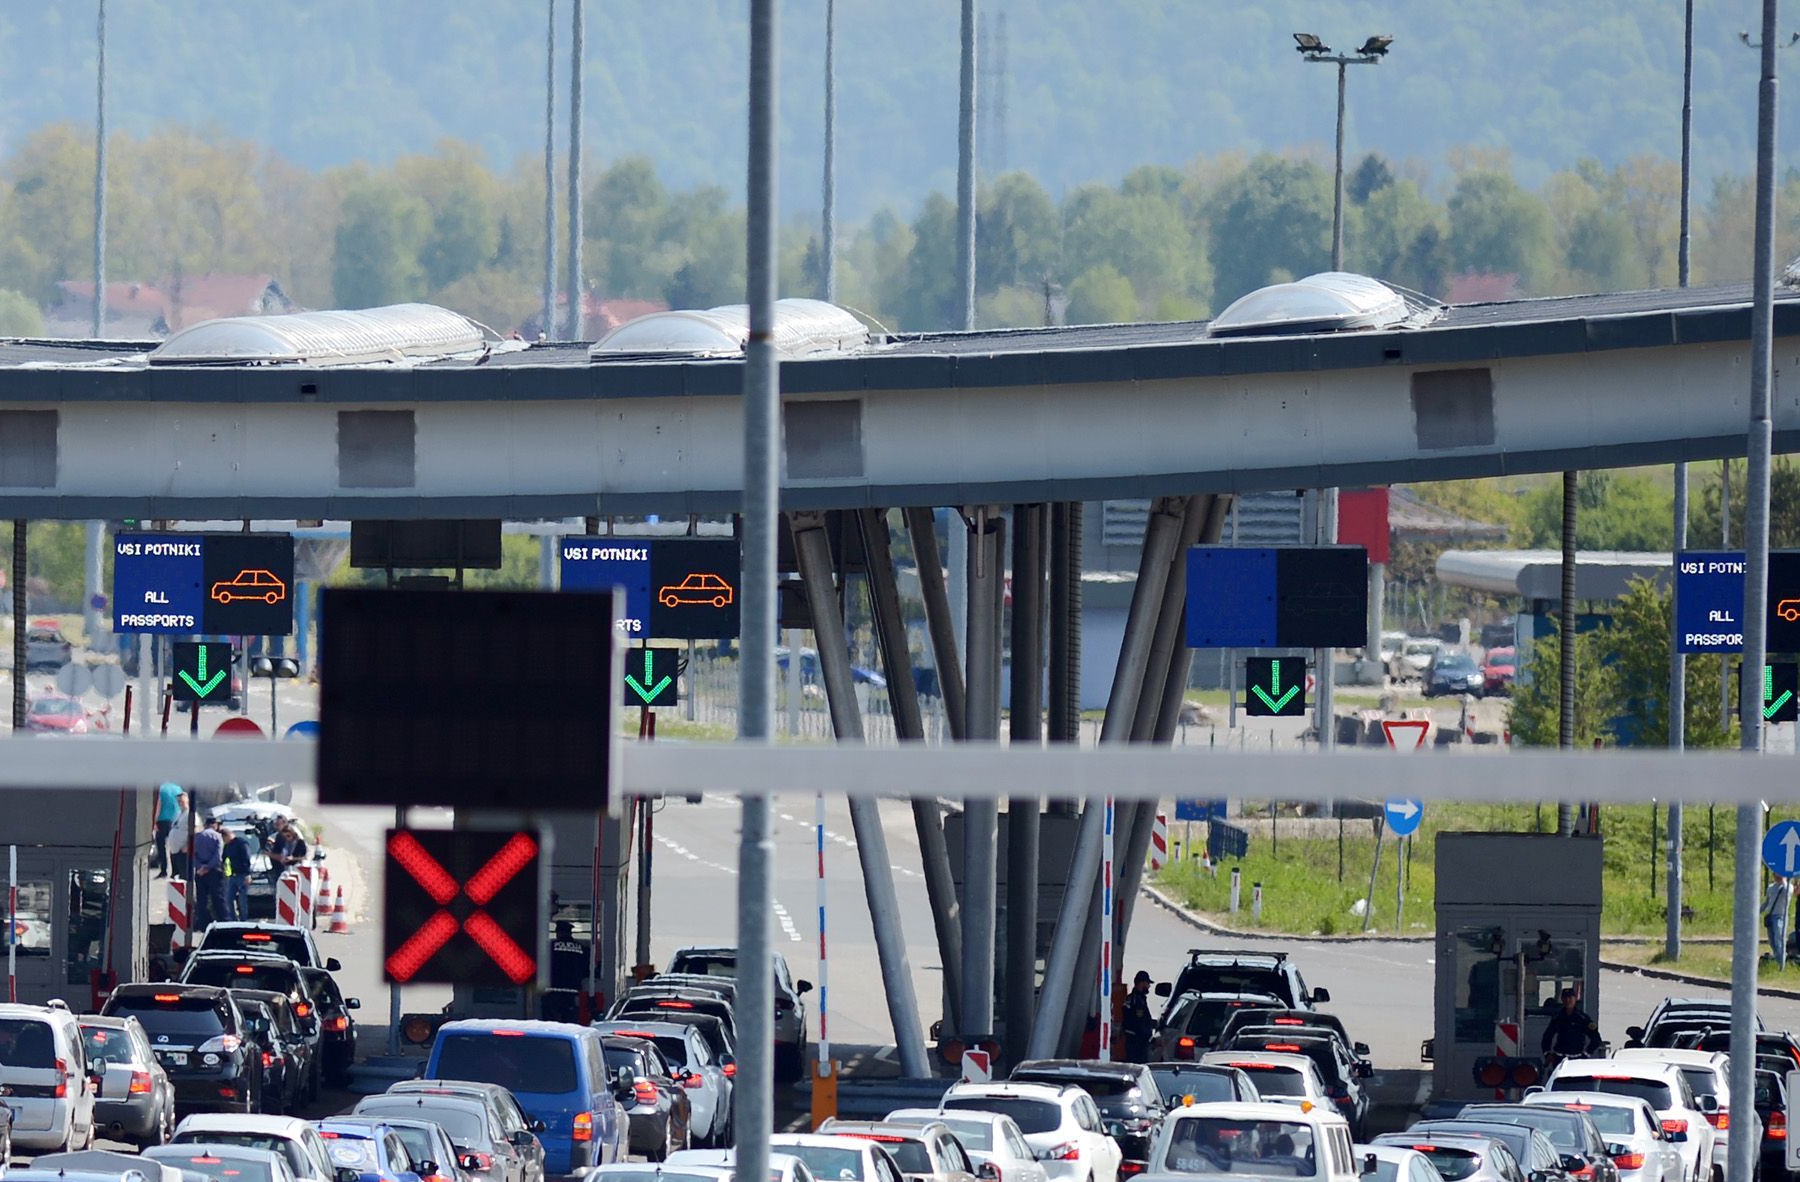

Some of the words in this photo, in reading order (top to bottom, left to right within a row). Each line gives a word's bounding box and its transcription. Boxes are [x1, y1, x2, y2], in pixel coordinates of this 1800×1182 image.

[117, 543, 141, 556] VSI
[145, 543, 201, 557] POTNIKI
[563, 547, 588, 560] VSI
[592, 548, 647, 561] POTNIKI
[1680, 562, 1705, 574] VSI
[144, 591, 169, 604] ALL
[120, 614, 194, 628] PASSPORTS
[1709, 610, 1735, 622] ALL
[1685, 633, 1743, 646] PASSPOR
